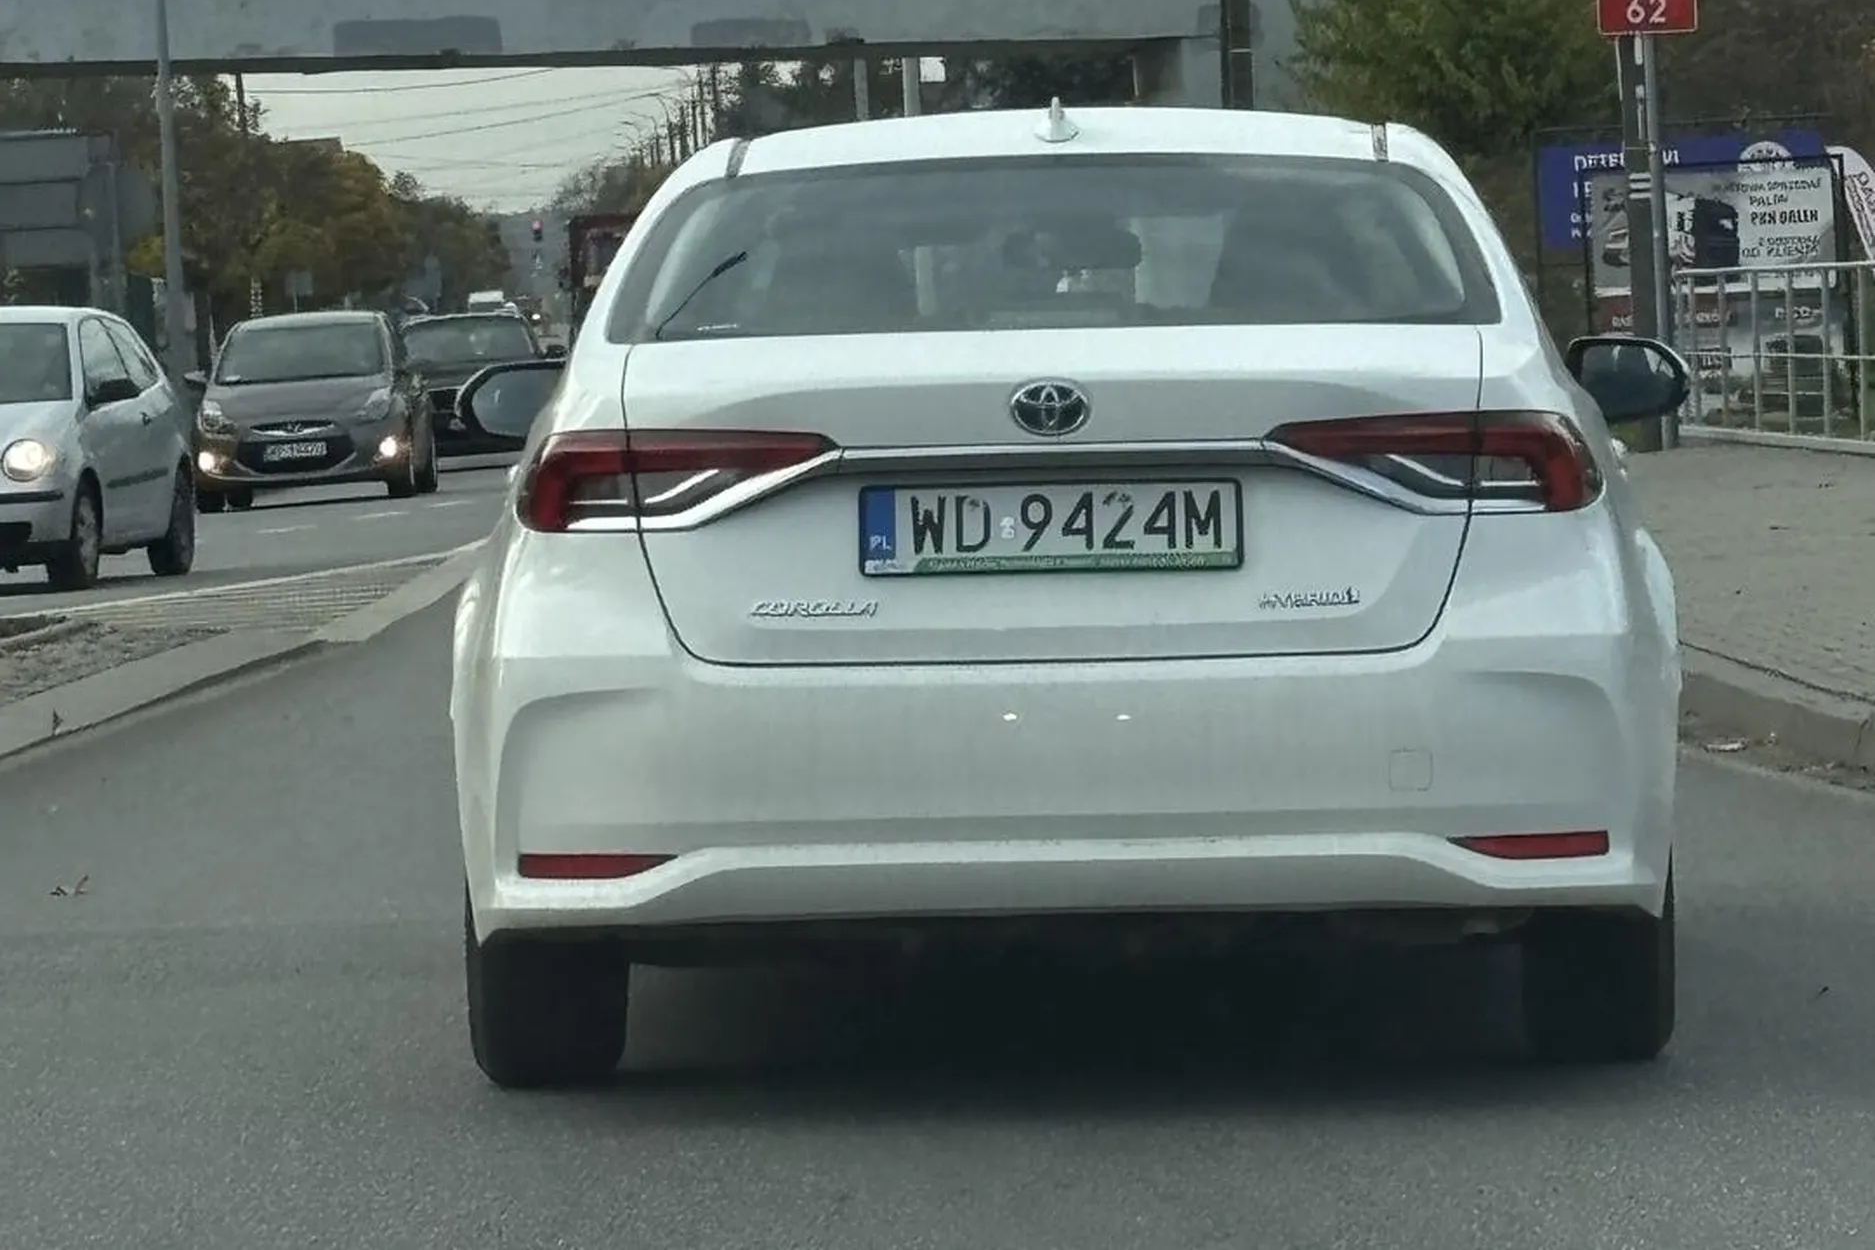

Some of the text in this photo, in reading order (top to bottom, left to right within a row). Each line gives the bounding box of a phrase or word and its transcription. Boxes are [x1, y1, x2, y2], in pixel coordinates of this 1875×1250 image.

[910, 490, 1222, 555] WD 9424M
[869, 535, 892, 550] PL
[750, 601, 879, 618] COROLLA
